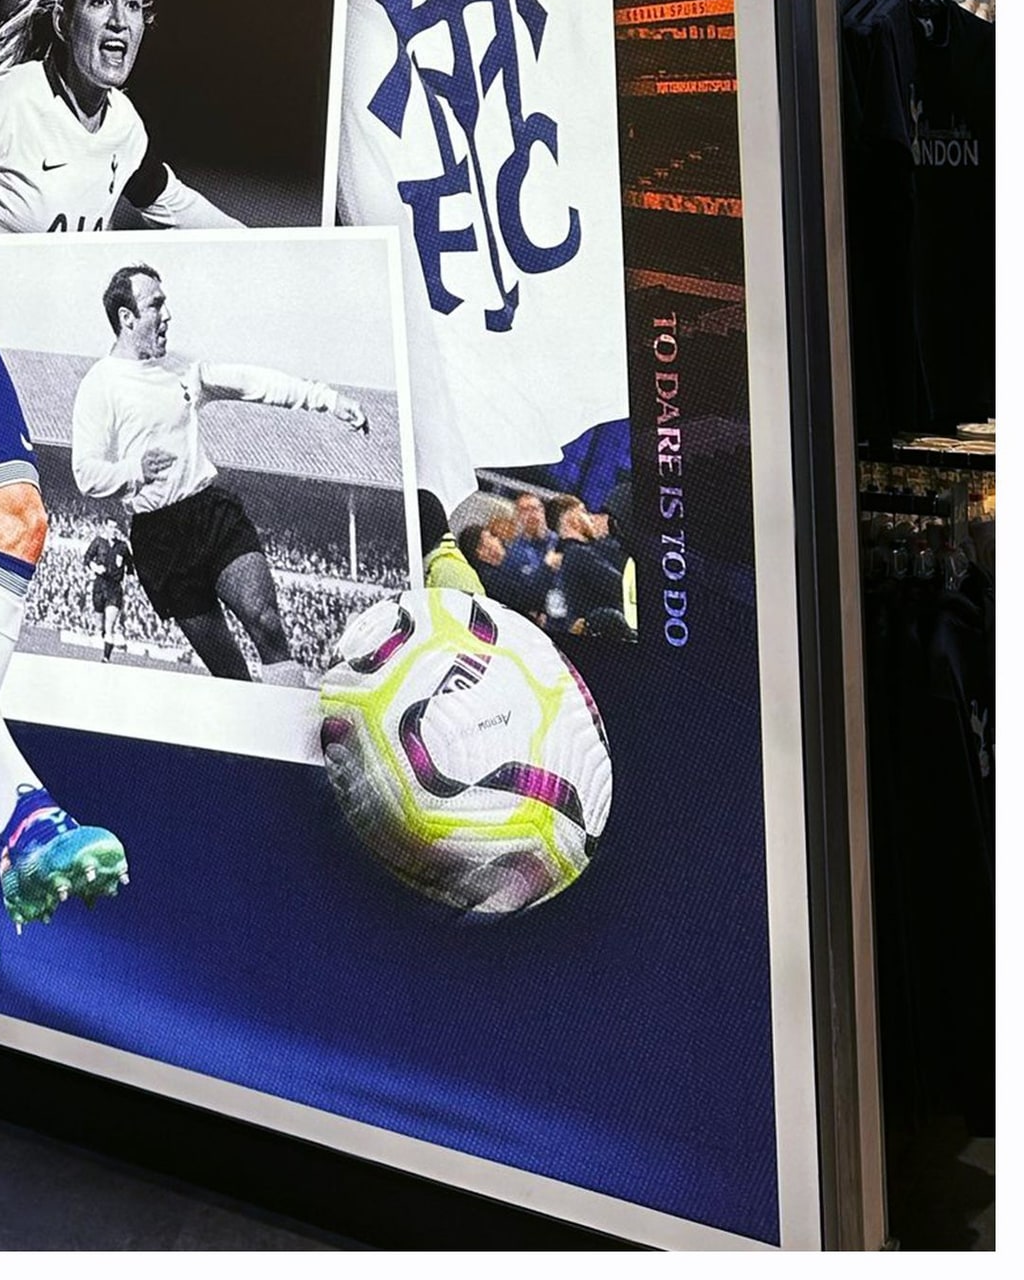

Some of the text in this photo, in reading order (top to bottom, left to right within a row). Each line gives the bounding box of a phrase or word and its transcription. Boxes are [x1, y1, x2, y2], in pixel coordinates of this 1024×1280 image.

[669, 1, 706, 18] SPURS
[653, 312, 689, 648] TO DARE IS TO DO
